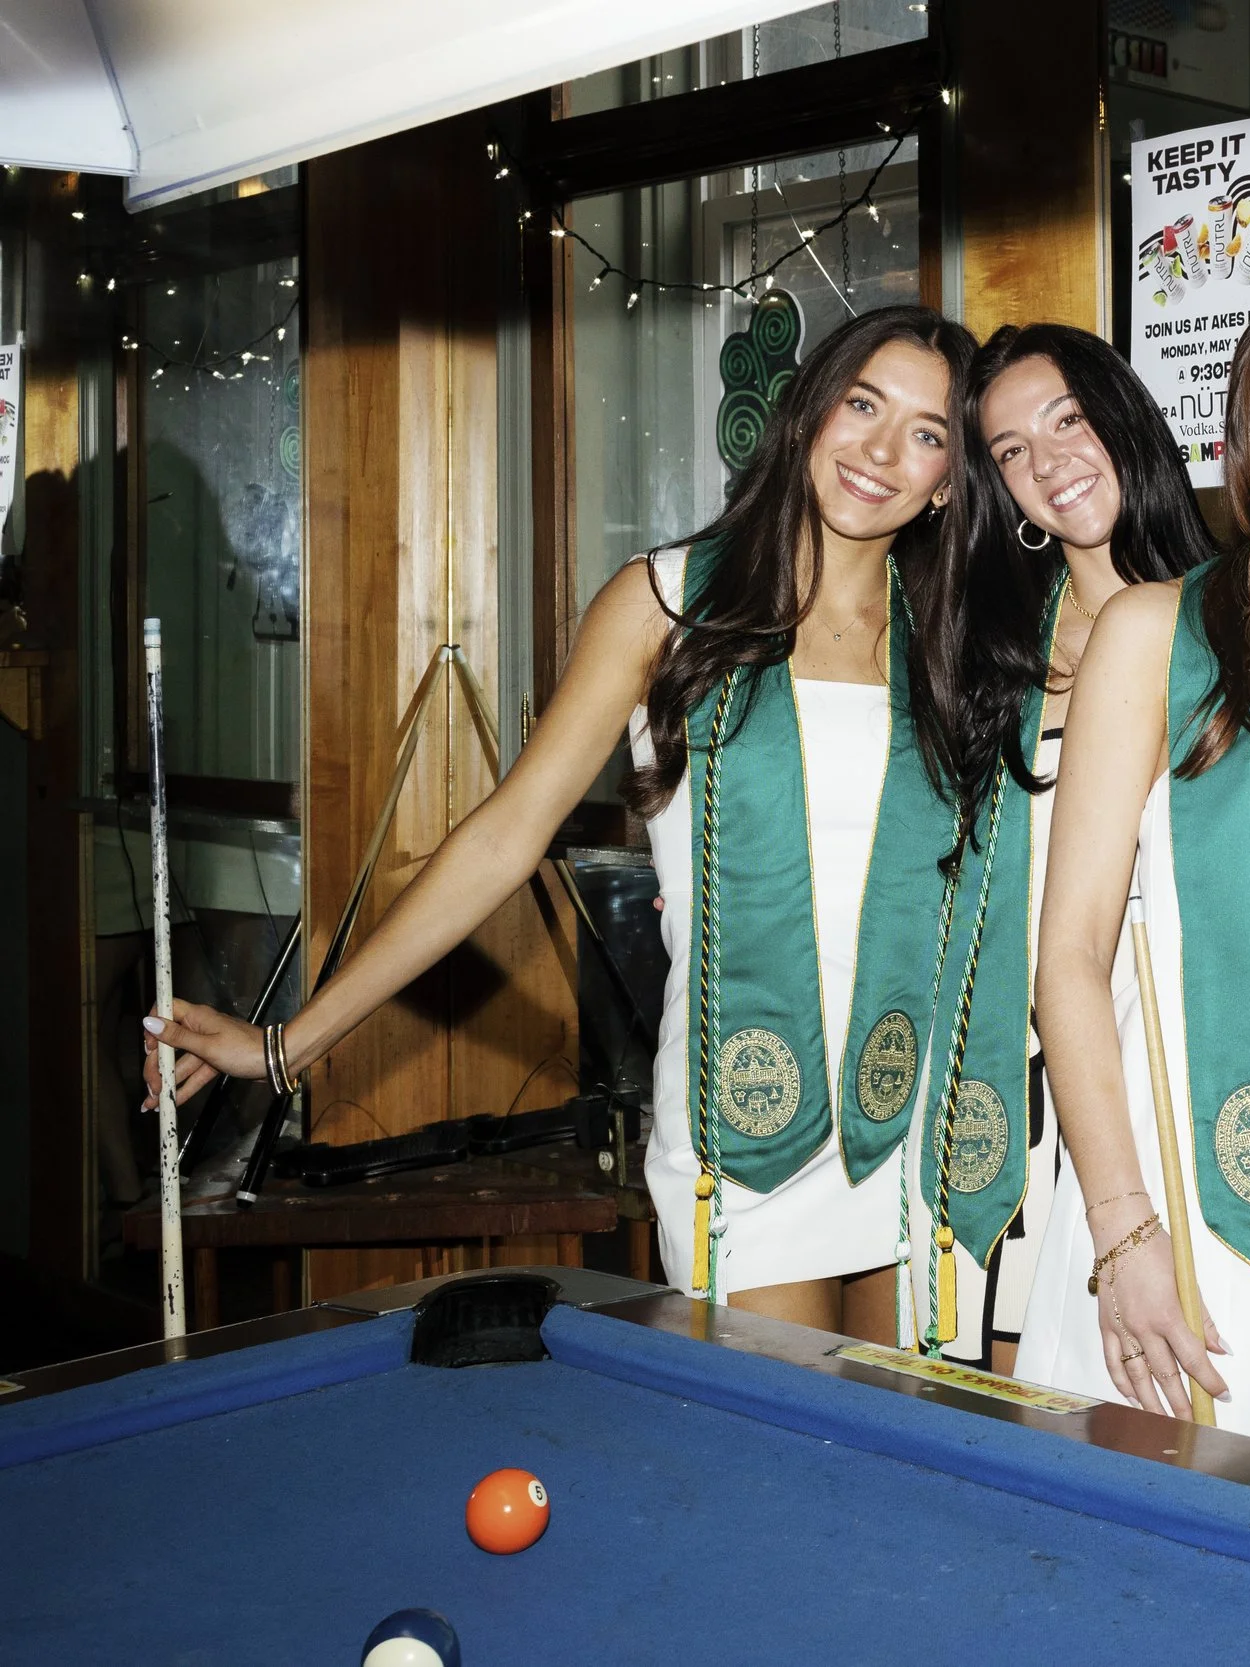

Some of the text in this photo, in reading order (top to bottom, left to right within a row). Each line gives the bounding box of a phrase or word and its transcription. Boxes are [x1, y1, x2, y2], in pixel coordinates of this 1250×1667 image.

[1148, 133, 1246, 173] KEEP IT
[1152, 160, 1236, 196] TASTY
[1145, 322, 1173, 339] JOIN
[1175, 319, 1191, 334] US
[1194, 316, 1208, 332] AT
[1211, 312, 1245, 330] AKES
[1161, 342, 1207, 360] MONDAY,
[1210, 338, 1232, 354] MAY
[1190, 361, 1232, 383] 9:30P
[535, 1485, 543, 1501] 5
